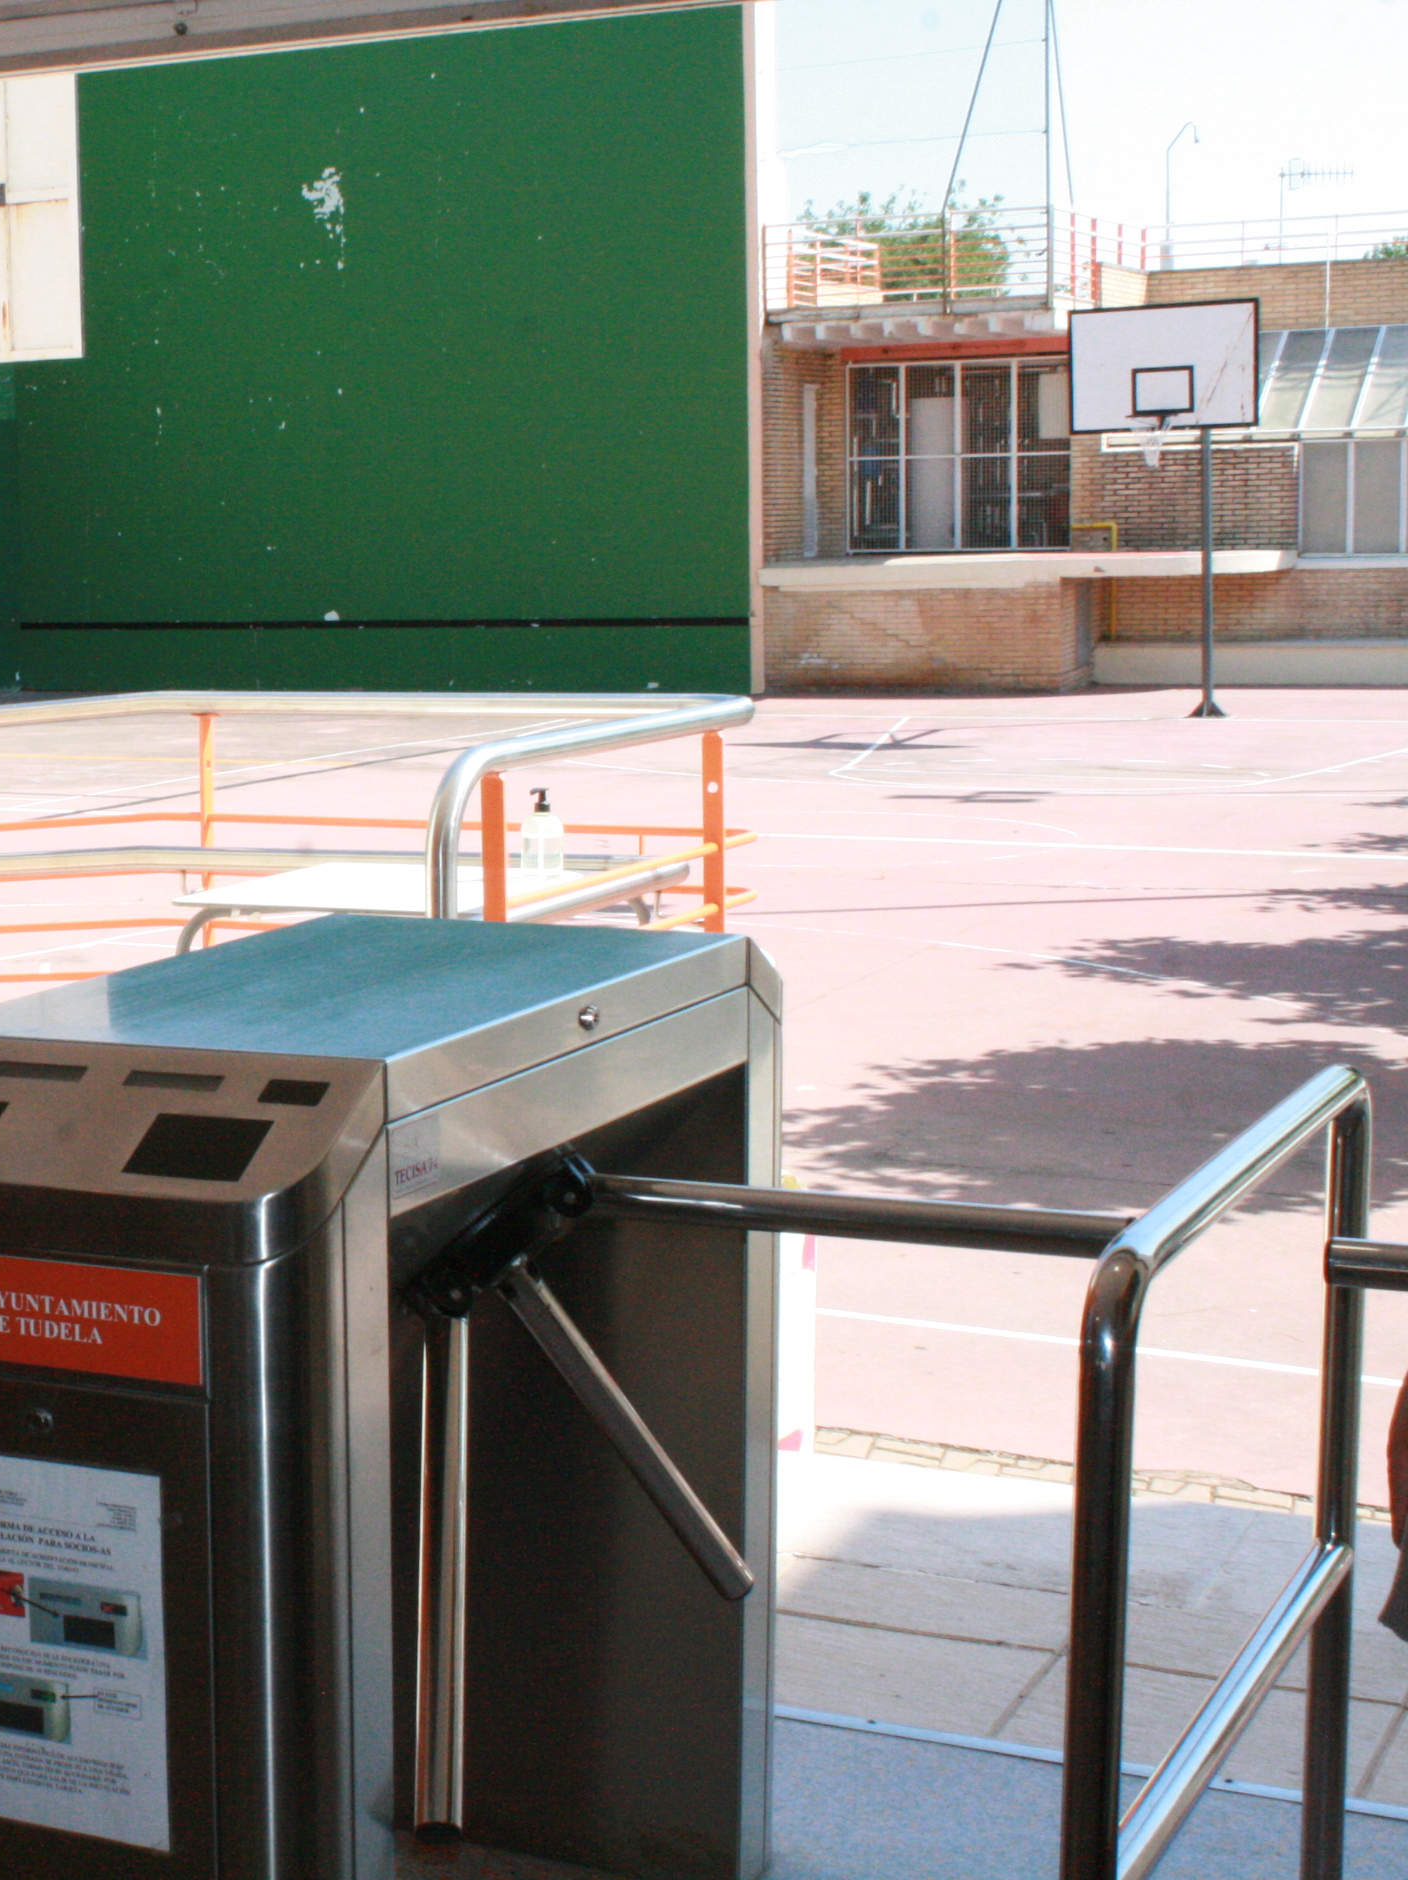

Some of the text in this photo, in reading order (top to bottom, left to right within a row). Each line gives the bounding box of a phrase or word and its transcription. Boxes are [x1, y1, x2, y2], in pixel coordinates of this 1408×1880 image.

[16, 1317, 103, 1345] TUDELA
[23, 1524, 34, 1532] DE
[38, 1527, 73, 1538] ACCESO
[83, 1532, 95, 1542] LA
[38, 1537, 63, 1548] PARA
[64, 1541, 111, 1555] SOCIOS-AS
